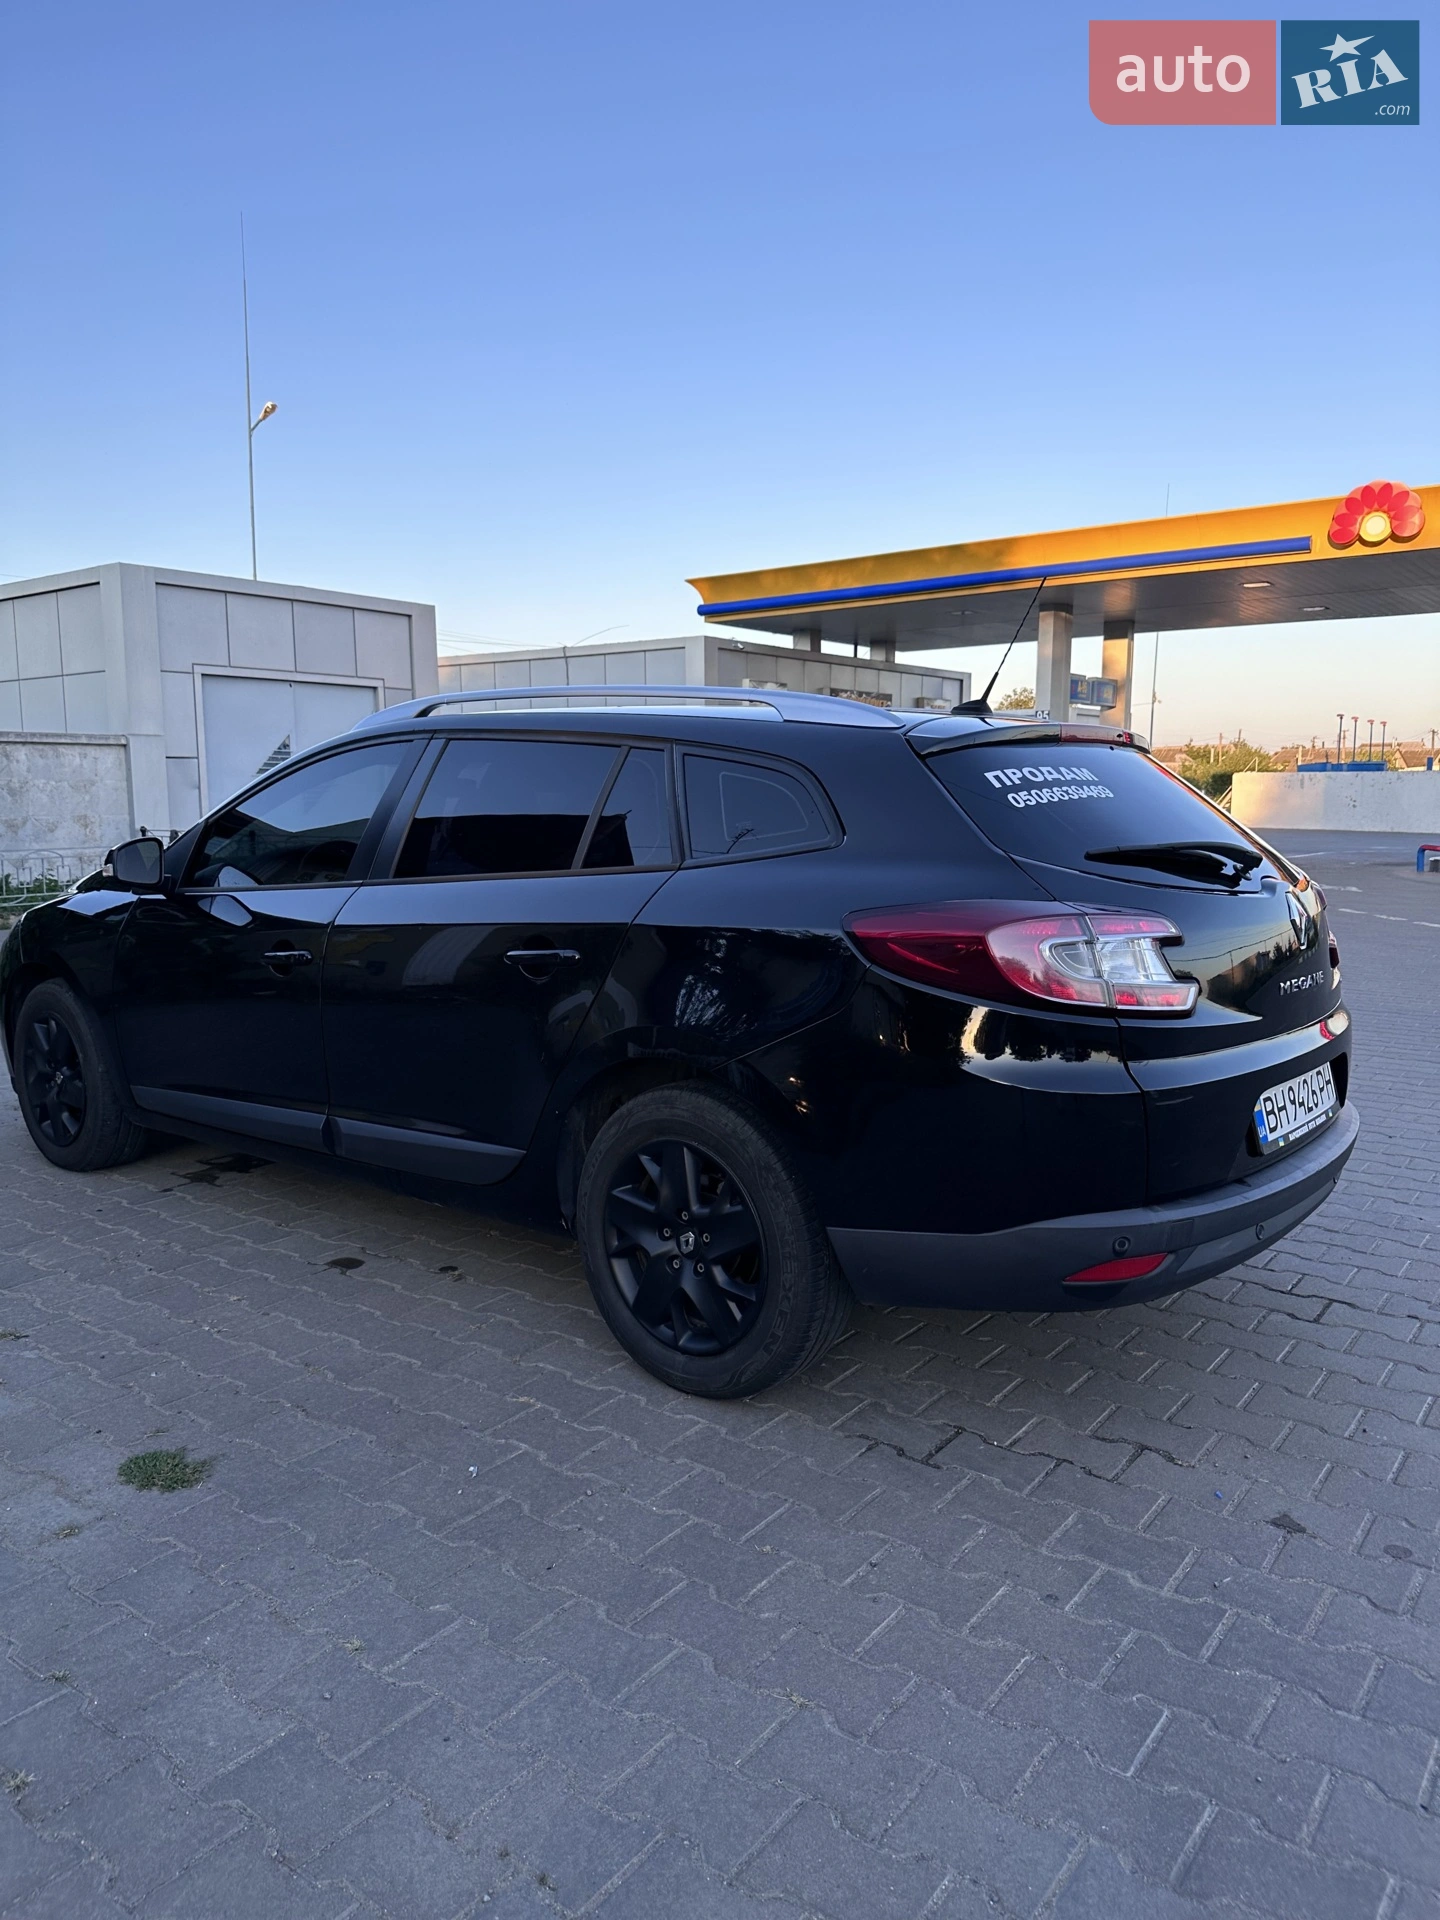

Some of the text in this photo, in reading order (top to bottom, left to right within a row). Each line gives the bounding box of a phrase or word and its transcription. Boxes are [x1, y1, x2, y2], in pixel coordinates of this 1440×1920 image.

[983, 766, 1099, 789] ПРОДАМ
[1007, 785, 1114, 808] 0506639469
[1279, 970, 1324, 996] MEGANE
[1257, 1125, 1267, 1138] UA
